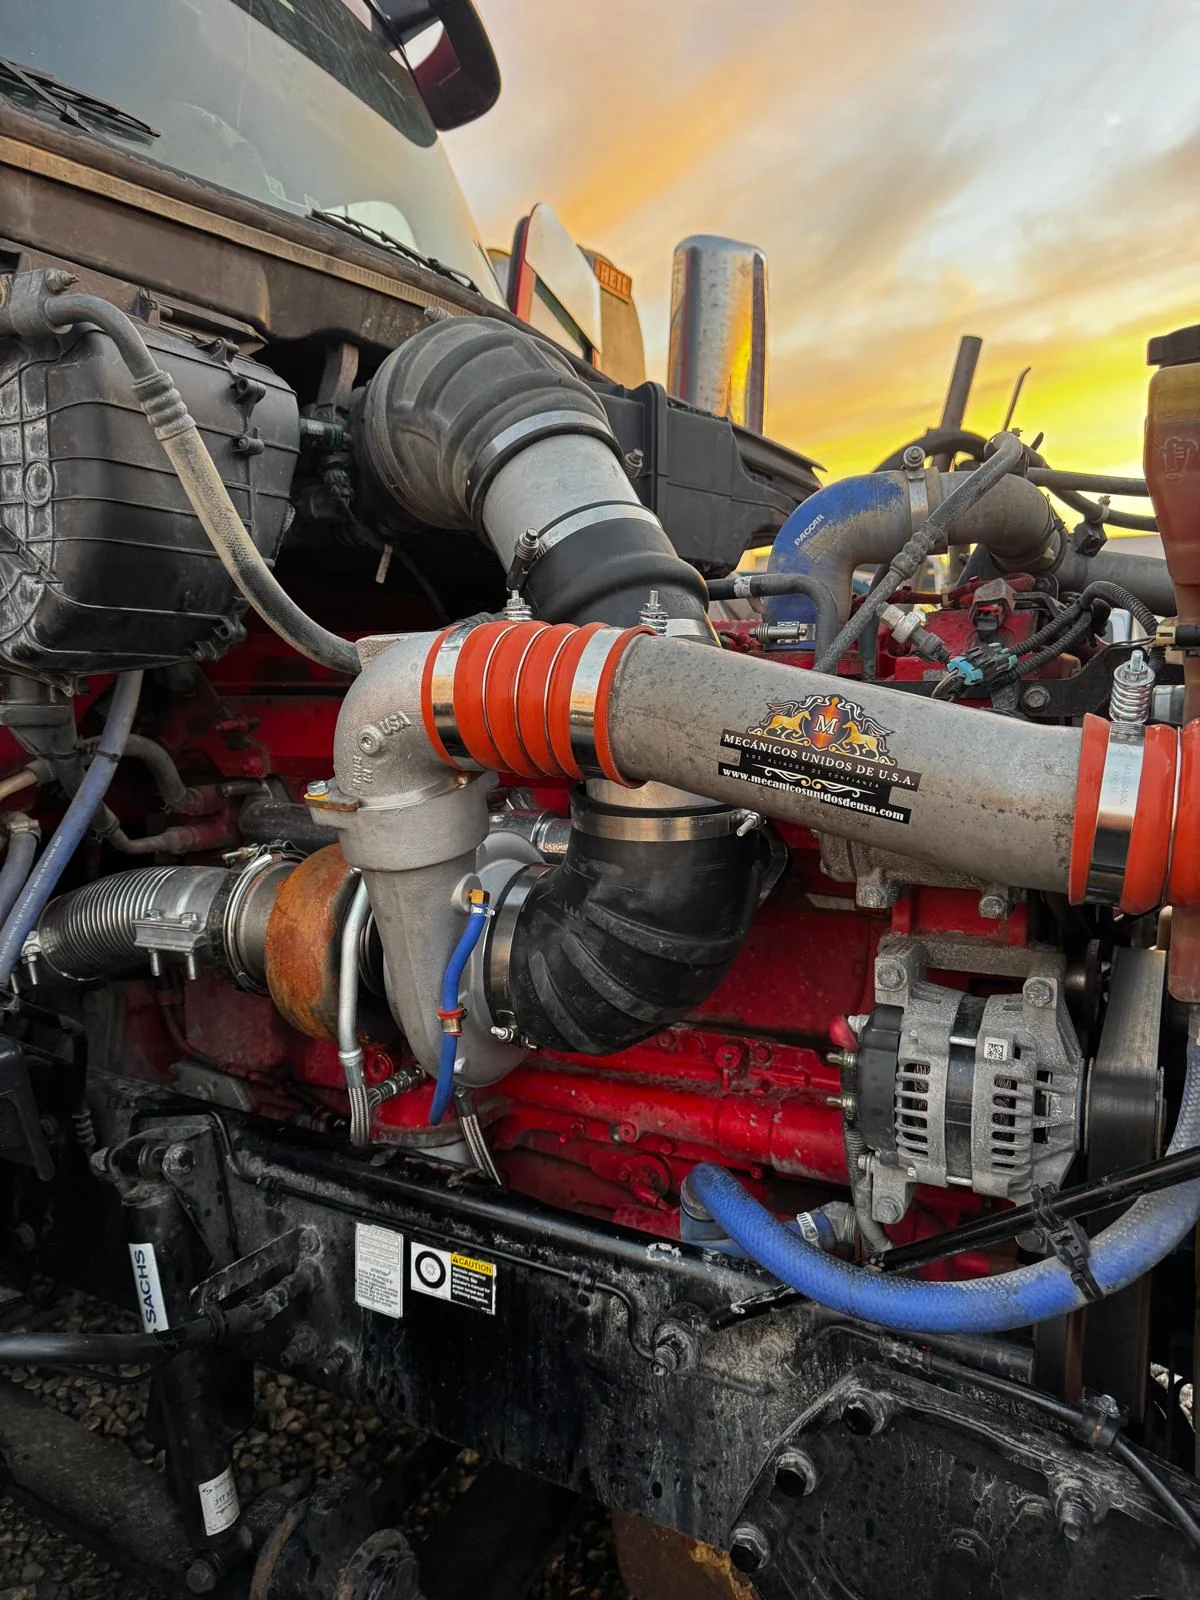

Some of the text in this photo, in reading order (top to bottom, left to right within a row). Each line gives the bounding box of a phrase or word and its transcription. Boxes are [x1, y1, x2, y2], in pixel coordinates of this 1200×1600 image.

[793, 514, 825, 546] PACCAR
[380, 711, 411, 735] USA
[814, 714, 839, 736] M
[723, 733, 915, 787] MECÁNICOS UNIDOS DE U.S.A.
[746, 753, 762, 761] LOS
[767, 758, 805, 772] ALIADOS
[828, 772, 880, 788] CONFIANZA
[722, 768, 904, 821] www.mecanicosunidosdeusa.com
[459, 1257, 493, 1274] CAUTION
[134, 1249, 156, 1324] SACHS
